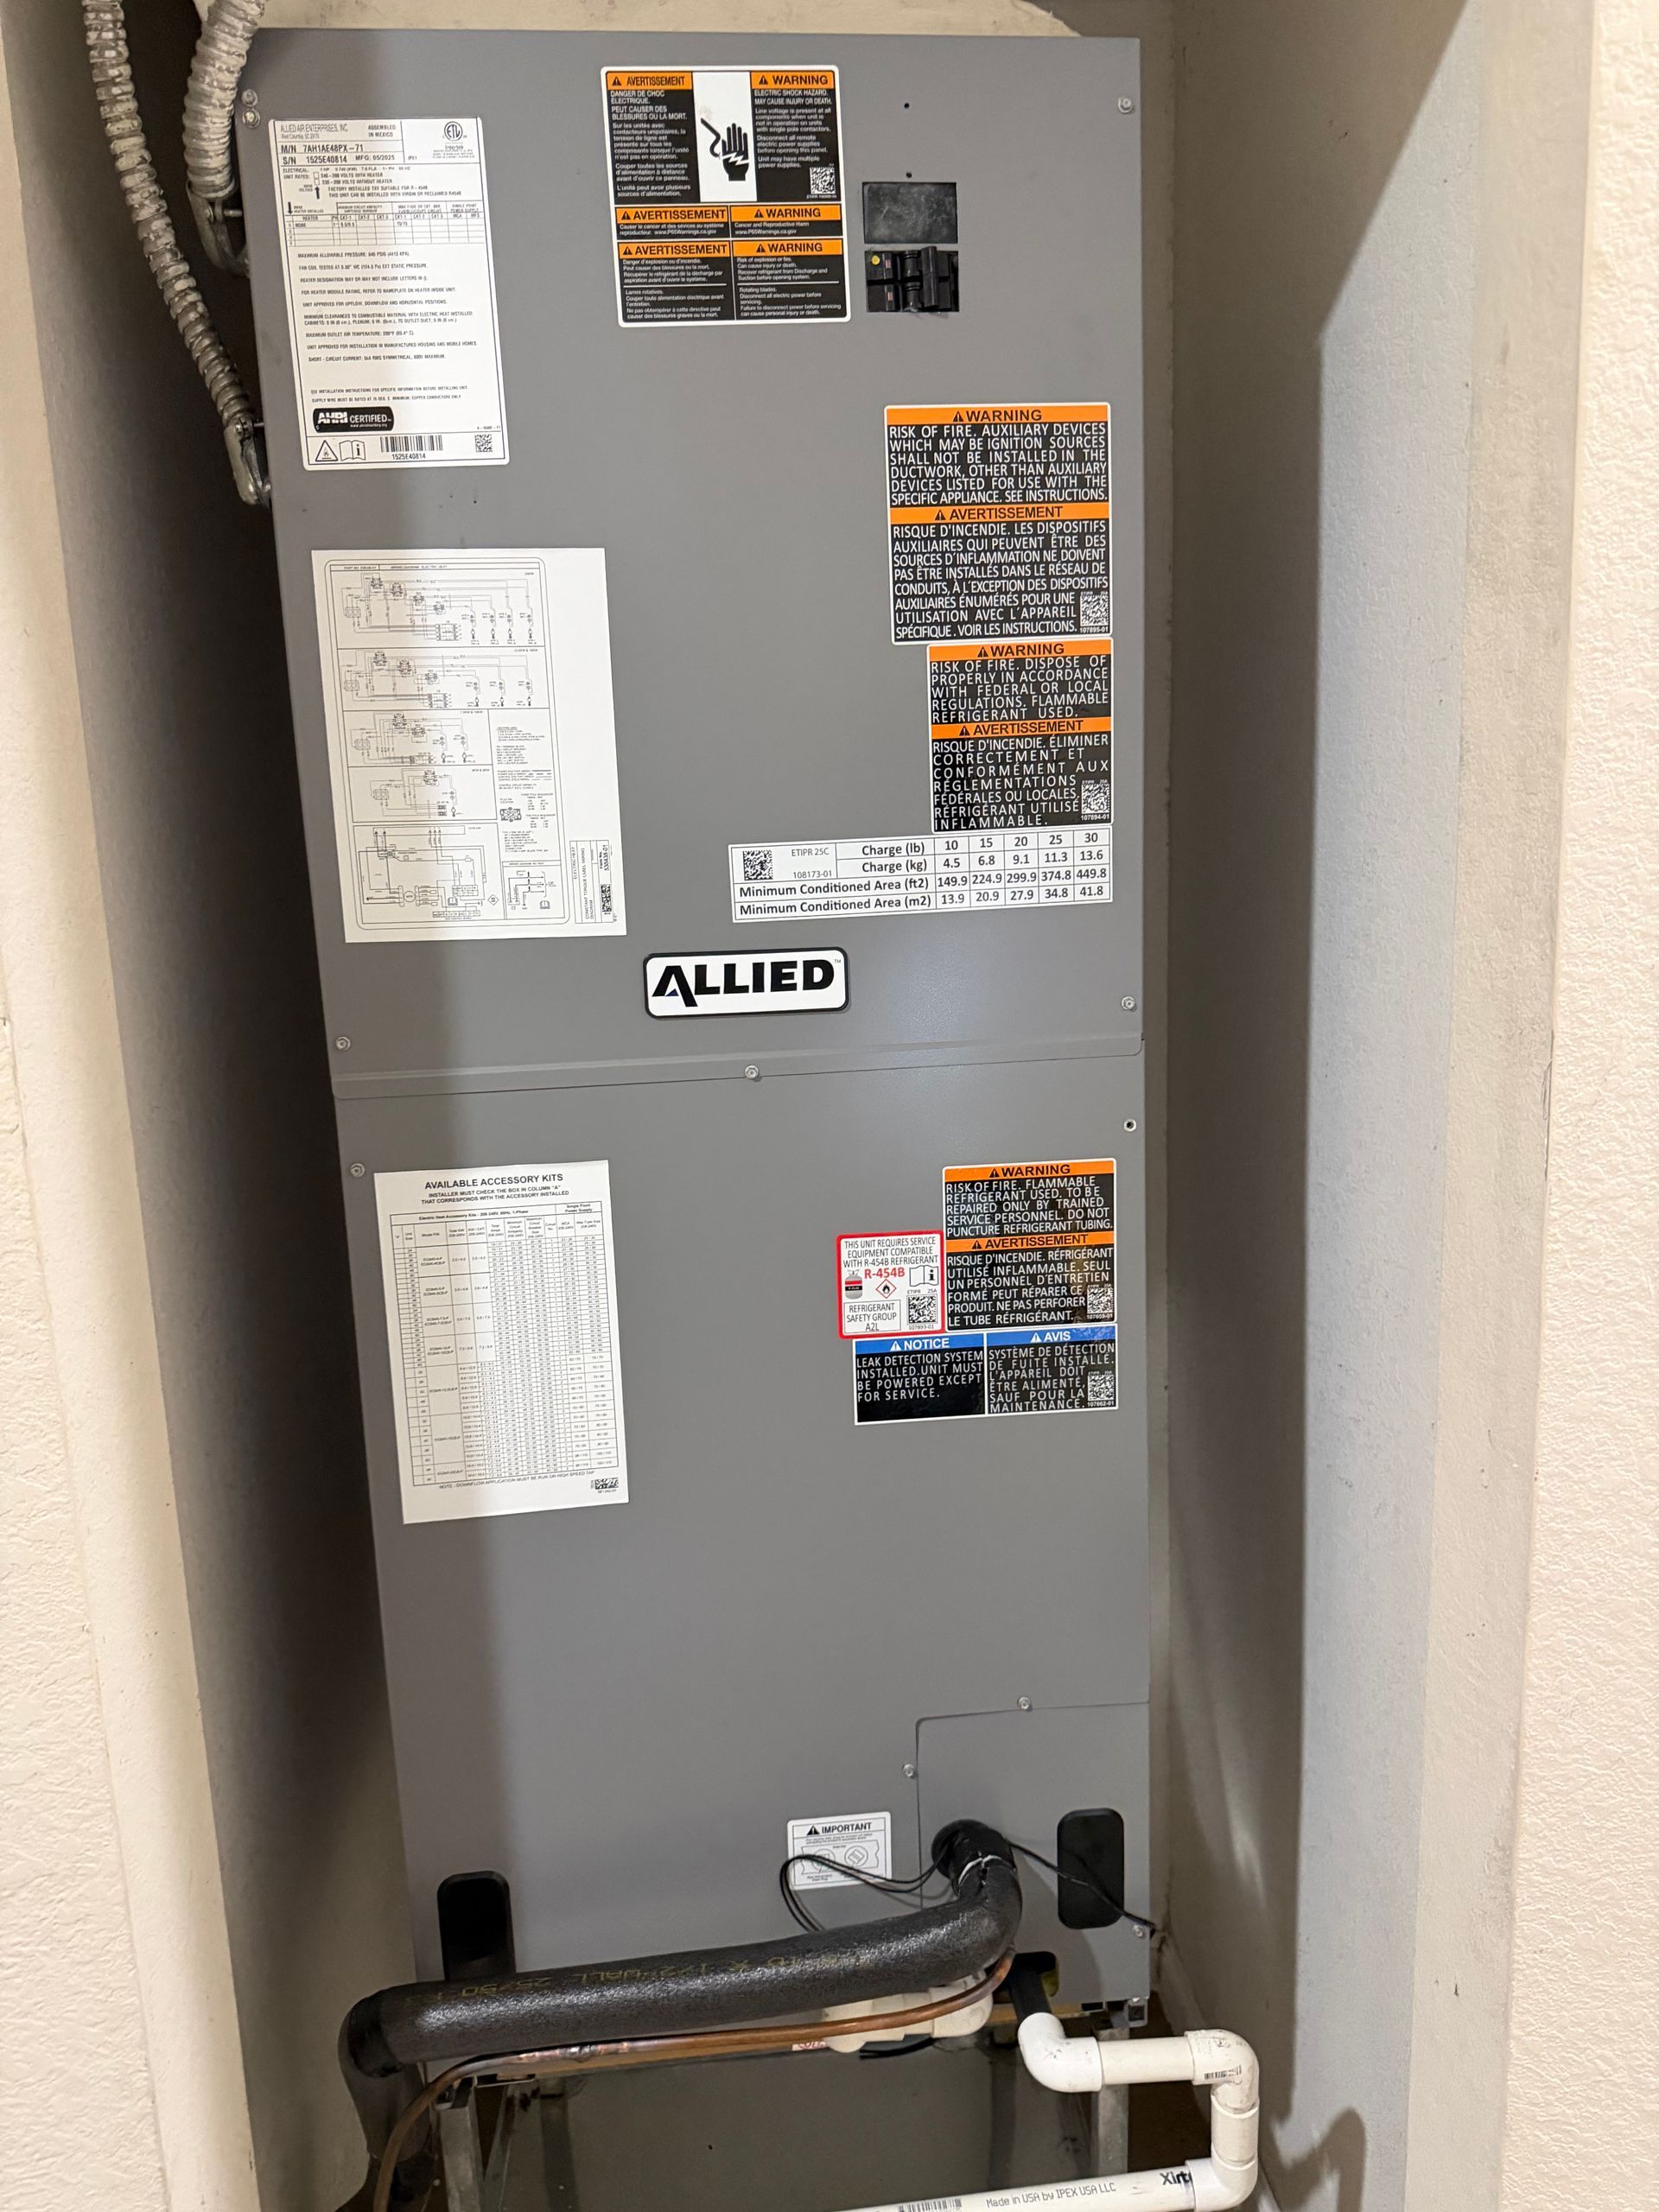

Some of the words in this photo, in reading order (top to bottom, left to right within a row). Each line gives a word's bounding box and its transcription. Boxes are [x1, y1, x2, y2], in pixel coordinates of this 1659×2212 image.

[626, 76, 684, 86] AVERTISSEMENT
[772, 75, 828, 85] WARNING
[283, 156, 296, 165] S/N
[633, 210, 726, 220] AVERTISSEMENT
[766, 208, 821, 218] WARNING
[635, 244, 727, 255] AVERTISSEMENT
[769, 243, 823, 252] WARNING
[318, 411, 347, 423] AHRI
[350, 414, 386, 423] CERTIFIED
[966, 410, 1041, 422] WARNING
[890, 426, 915, 438] RISK
[921, 426, 938, 437] OF
[944, 425, 976, 437] FIRE.
[982, 424, 1048, 436] AUXILIARY
[1053, 423, 1105, 435] DEVICES
[890, 439, 931, 452] WHICH
[939, 439, 964, 451] MAY
[969, 438, 983, 450] BE
[988, 437, 1042, 450] IGNITION
[1050, 436, 1105, 448] SOURCES
[950, 506, 1063, 520] AVERTISSEMENT
[893, 538, 963, 553] AUXILIAIRES
[967, 538, 988, 550] QUI
[992, 537, 1044, 550] PEUVENT
[1051, 535, 1077, 549] ÊTRE
[1085, 535, 1106, 547] DES
[991, 644, 1065, 657] WARNING
[932, 661, 959, 673] RISK
[965, 660, 982, 672] OF
[988, 659, 1020, 671] FIRE.
[1026, 657, 1079, 670] DISPOSE
[1090, 656, 1107, 667] OF
[932, 672, 996, 685] PROPERLY
[1001, 671, 1014, 683] IN
[1020, 668, 1108, 682] ACCORDANCE
[974, 721, 1084, 735] AVERTISSEMENT
[862, 846, 902, 857] Charge
[906, 842, 925, 855] (lb)
[944, 840, 957, 850] 10
[980, 838, 993, 848] 15
[1014, 836, 1028, 847] 20
[1049, 835, 1063, 844] 25
[1085, 833, 1098, 842] 30
[862, 861, 902, 874] Charge
[906, 859, 927, 872] (kg)
[944, 858, 960, 868] 4.5
[978, 855, 995, 866] 6.8
[1013, 854, 1029, 864] 9.1
[1045, 852, 1068, 862] 11.3
[1080, 850, 1103, 861] 13.6
[740, 886, 796, 897] Minimum
[800, 881, 870, 894] Conditioned
[874, 880, 901, 891] Area
[905, 878, 929, 890] (ft2)
[938, 876, 967, 887] 149.9
[972, 874, 1002, 885] 224.9
[1007, 872, 1037, 883] 299.9
[1041, 870, 1071, 881] 374.8
[1077, 868, 1107, 879] 449.8
[652, 959, 835, 1007] ALLIED
[1001, 1165, 1071, 1177] WARNING
[425, 1179, 478, 1189] AVAILABLE
[480, 1175, 539, 1187] ACCESSORY
[947, 1224, 1000, 1237] PUNCTURE
[1004, 1221, 1073, 1234] REFRIGERANT
[1076, 1219, 1113, 1230] TUBING.
[878, 1238, 909, 1247] REQUIRES
[911, 1236, 936, 1245] SERVICE
[985, 1234, 1089, 1249] AVERTISSEMENT
[848, 1249, 888, 1258] EQUIPMENT
[891, 1246, 932, 1256] COMPATIBLE
[864, 1258, 889, 1267] R-454B
[891, 1255, 938, 1265] REFRIGERANT
[864, 1268, 905, 1279] R-454B
[849, 1303, 894, 1313] REFRIGERANT
[873, 1313, 897, 1321] GROUP
[866, 1322, 880, 1331] A2L
[1044, 1332, 1071, 1342] AVIS
[904, 1338, 950, 1350] NOTICE
[857, 1357, 880, 1368] LEAK
[885, 1353, 941, 1366] DETECTION
[944, 1351, 983, 1362] SYSTEM
[858, 1381, 871, 1391] BE
[877, 1376, 933, 1389] POWERED
[939, 1374, 981, 1385] EXCEPT
[858, 1392, 880, 1402] FOR
[886, 1388, 940, 1400] SERVICE.
[822, 1822, 872, 1834] IMPORTANT
[987, 2197, 1009, 2208] Made
[1013, 2195, 1020, 2204] in
[1022, 2193, 1040, 2202] USA
[1042, 2191, 1054, 2202] by
[1056, 2189, 1077, 2198] IPEX
[1079, 2185, 1097, 2196] USA
[1099, 2183, 1116, 2193] LLC
